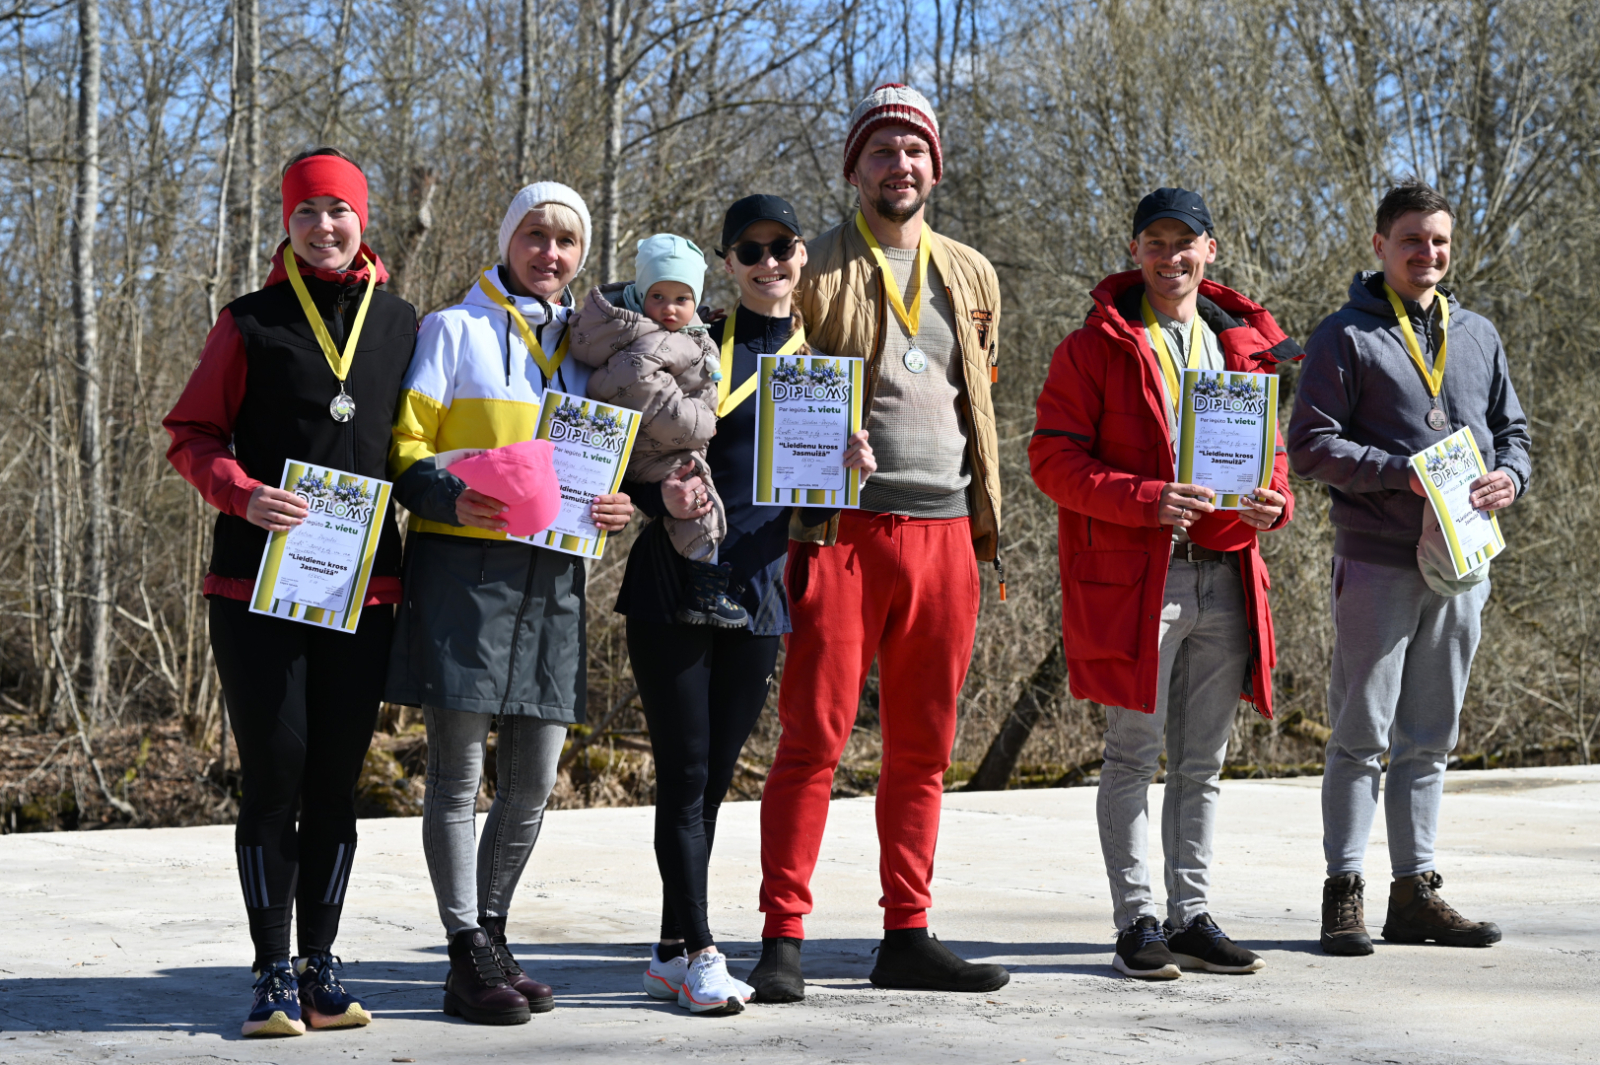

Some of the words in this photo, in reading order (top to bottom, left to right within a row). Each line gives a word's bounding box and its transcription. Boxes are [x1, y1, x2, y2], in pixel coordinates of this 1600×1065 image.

[773, 383, 849, 402] DIPLOMS
[818, 405, 841, 414] vietu
[1194, 395, 1264, 415] DIPLOMS
[1235, 417, 1256, 426] vietu
[550, 421, 624, 454] DIPLOMS
[582, 451, 590, 459] 1.
[590, 452, 612, 465] vietu
[1431, 451, 1476, 488] DIPLOMS
[559, 485, 583, 495] ldienu
[325, 521, 333, 529] 2.
[335, 523, 359, 535] vietu
[327, 561, 348, 571] kross
